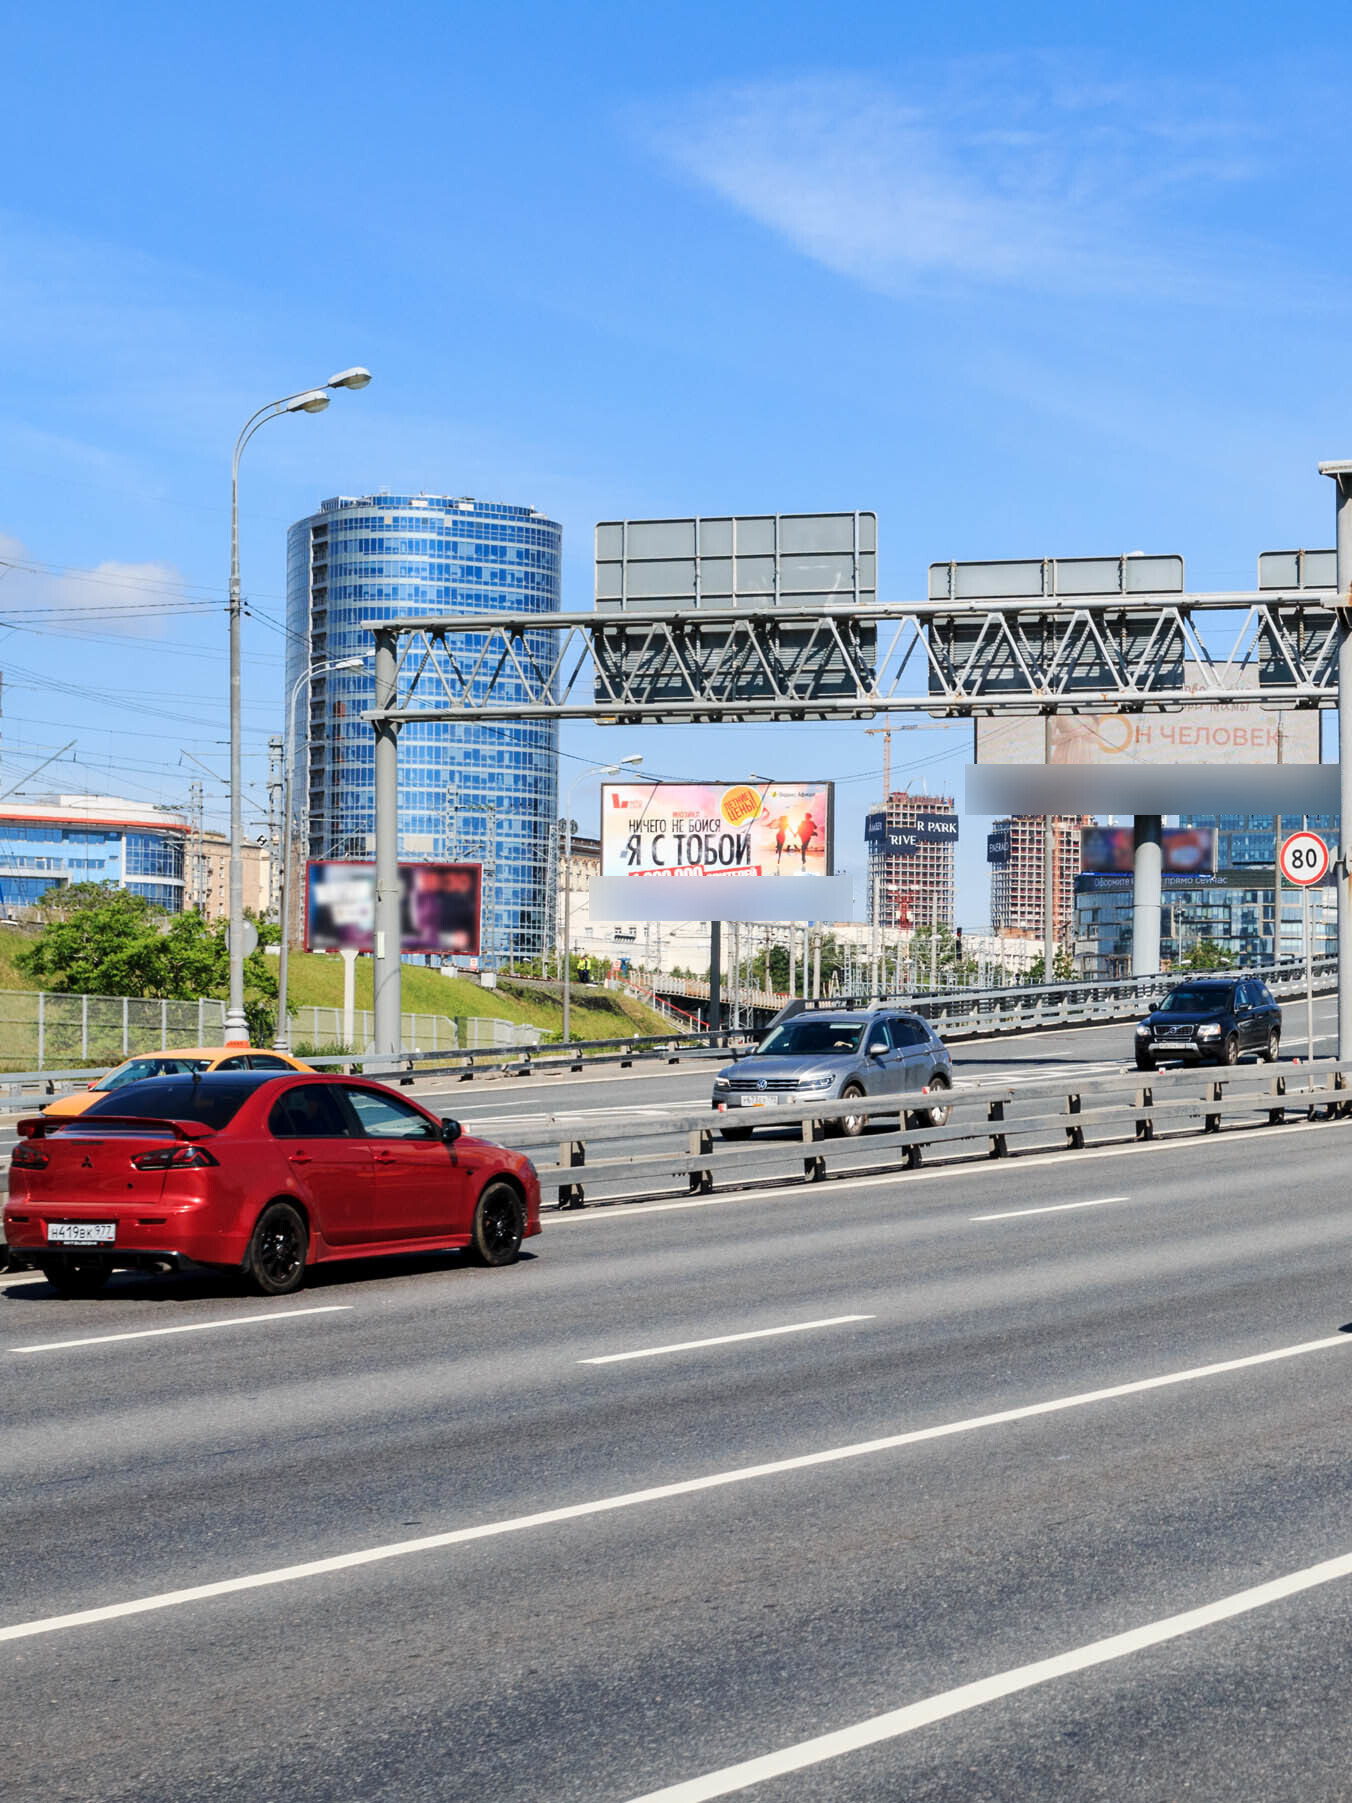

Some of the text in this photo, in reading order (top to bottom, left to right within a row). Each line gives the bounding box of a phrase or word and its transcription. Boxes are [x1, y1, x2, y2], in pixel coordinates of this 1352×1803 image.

[628, 818, 667, 833] НИЧЕГО
[671, 818, 684, 833] НЕ
[927, 822, 957, 833] PARK
[627, 834, 642, 866] Я
[652, 833, 666, 866] С
[1291, 848, 1317, 869] 80
